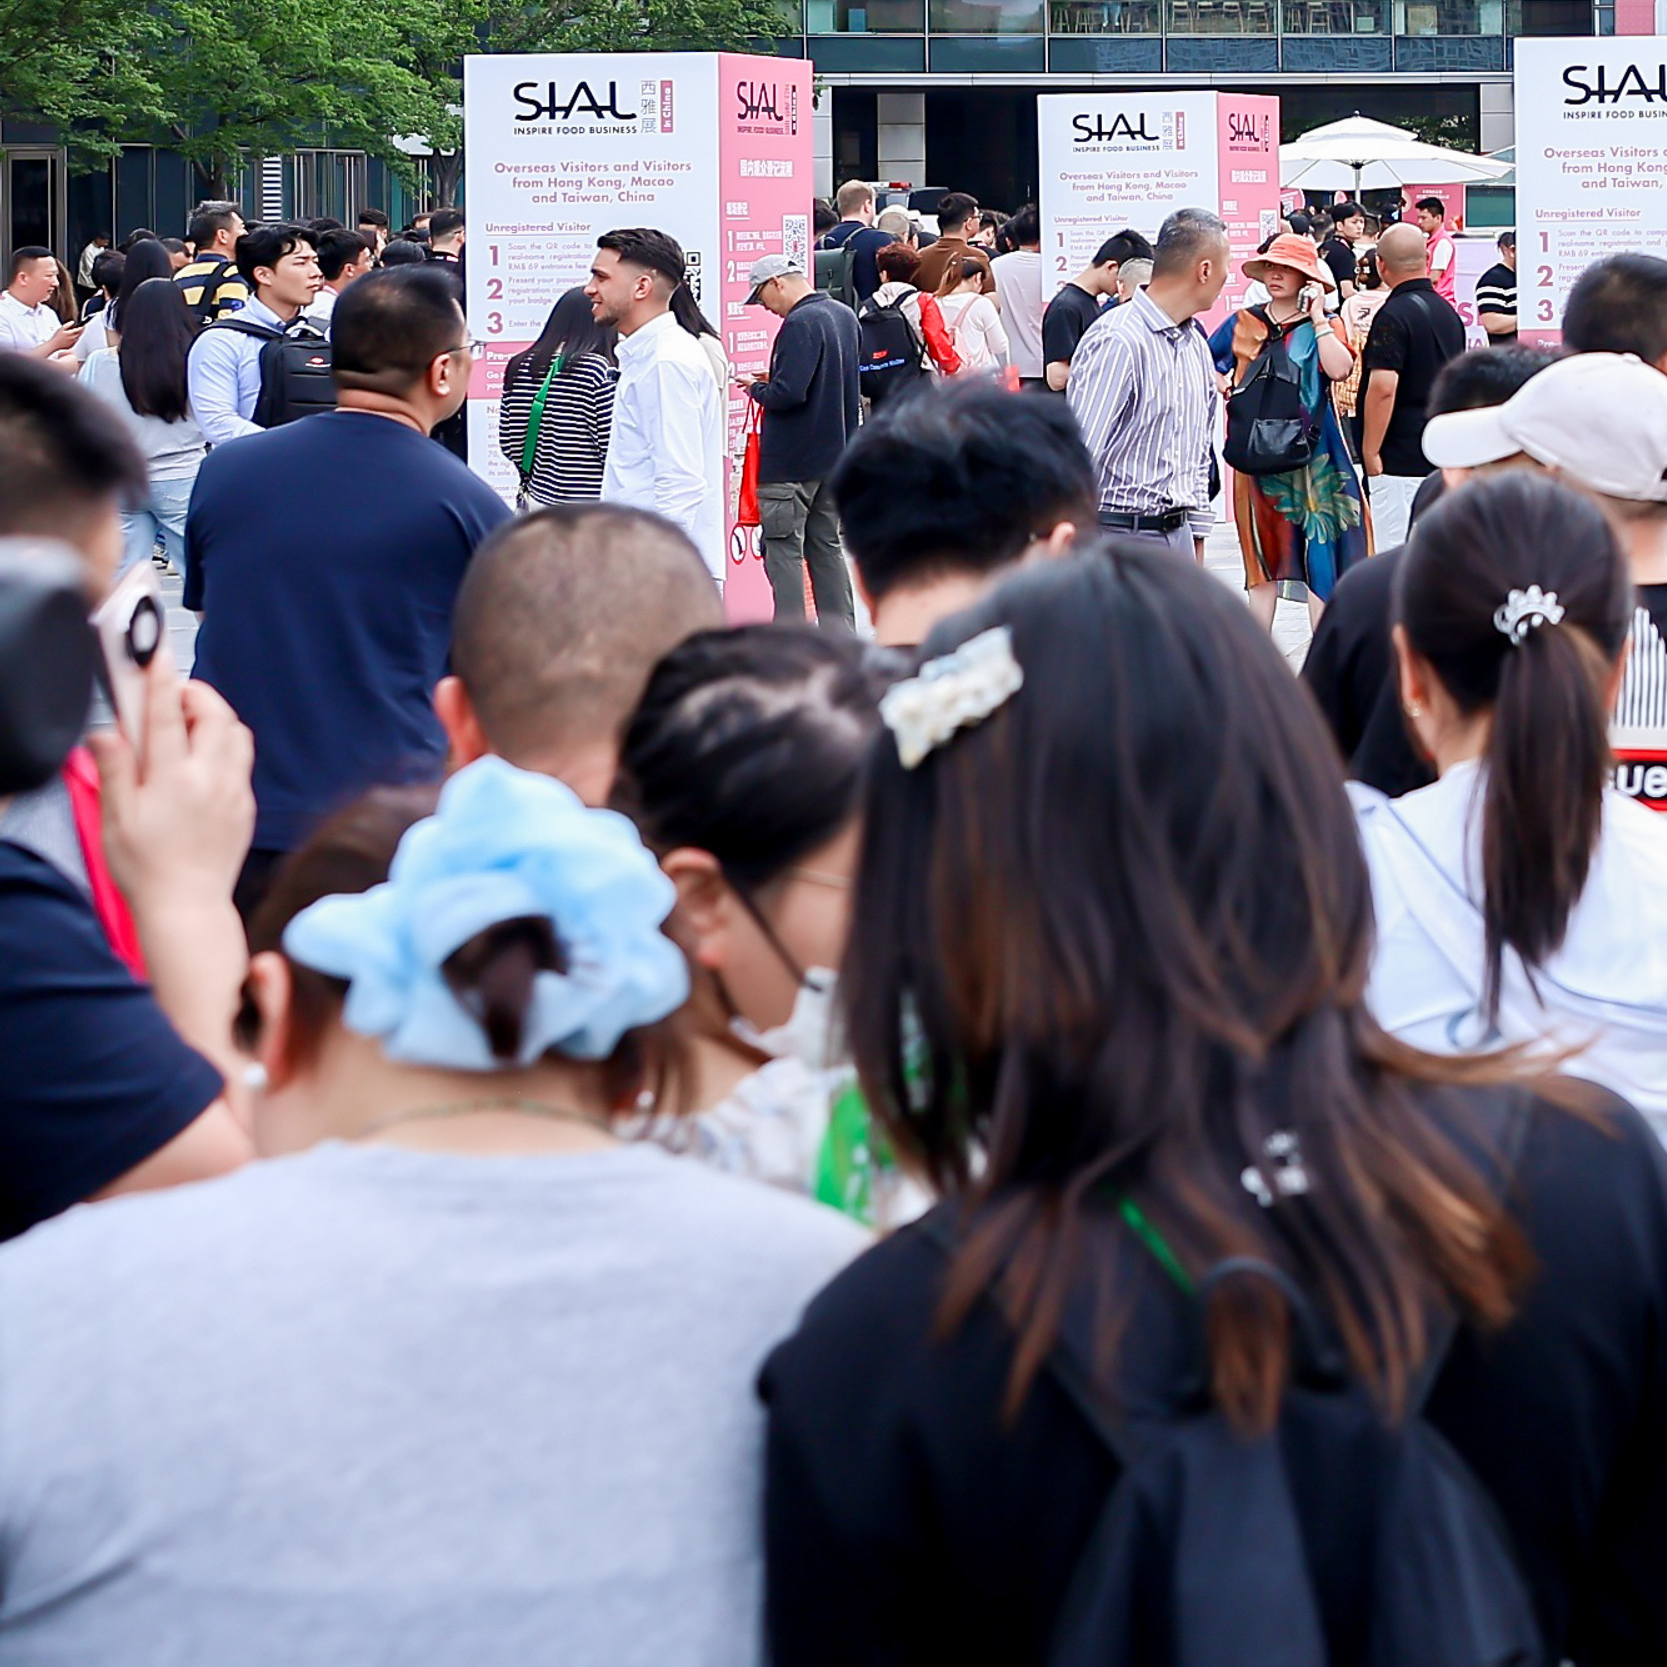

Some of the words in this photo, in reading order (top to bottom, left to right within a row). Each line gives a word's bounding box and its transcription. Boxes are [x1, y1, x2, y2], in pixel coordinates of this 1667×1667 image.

[513, 82, 637, 121] SIAL
[640, 80, 656, 133] 西雅展
[663, 87, 672, 115] China
[737, 82, 783, 121] SIAL
[1563, 111, 1601, 119] INSPIRE
[514, 127, 552, 135] INSPIRE
[556, 127, 585, 135] FOOD
[589, 126, 637, 134] BUSINESS
[1073, 113, 1159, 142] SIAL
[1229, 113, 1260, 141] SIAL
[1544, 147, 1605, 159] Overseas
[1610, 146, 1659, 158] Visitors
[494, 162, 556, 174] Overseas
[561, 162, 609, 173] Visitors
[614, 161, 638, 172] and
[643, 160, 691, 171] Visitors
[1562, 162, 1593, 174] from
[1597, 162, 1632, 176] Hong
[512, 177, 543, 188] from
[548, 177, 583, 191] Hong
[588, 176, 626, 189] Kong,
[631, 176, 674, 187] Macao
[1581, 178, 1607, 189] and
[1611, 178, 1663, 189] Taiwan,
[532, 192, 557, 204] and
[562, 192, 614, 204] Taiwan,
[618, 191, 655, 202] China
[1535, 209, 1604, 222] Unregistered
[1607, 208, 1641, 218] Visitor
[486, 223, 554, 234] Unregistered
[557, 222, 591, 231] Visitor
[1558, 229, 1576, 237] Scan
[1612, 228, 1630, 236] code
[1539, 232, 1549, 253] 1
[1599, 238, 1642, 248] registration
[1646, 238, 1661, 246] and
[1537, 265, 1554, 287] 2
[1537, 299, 1554, 321] 3
